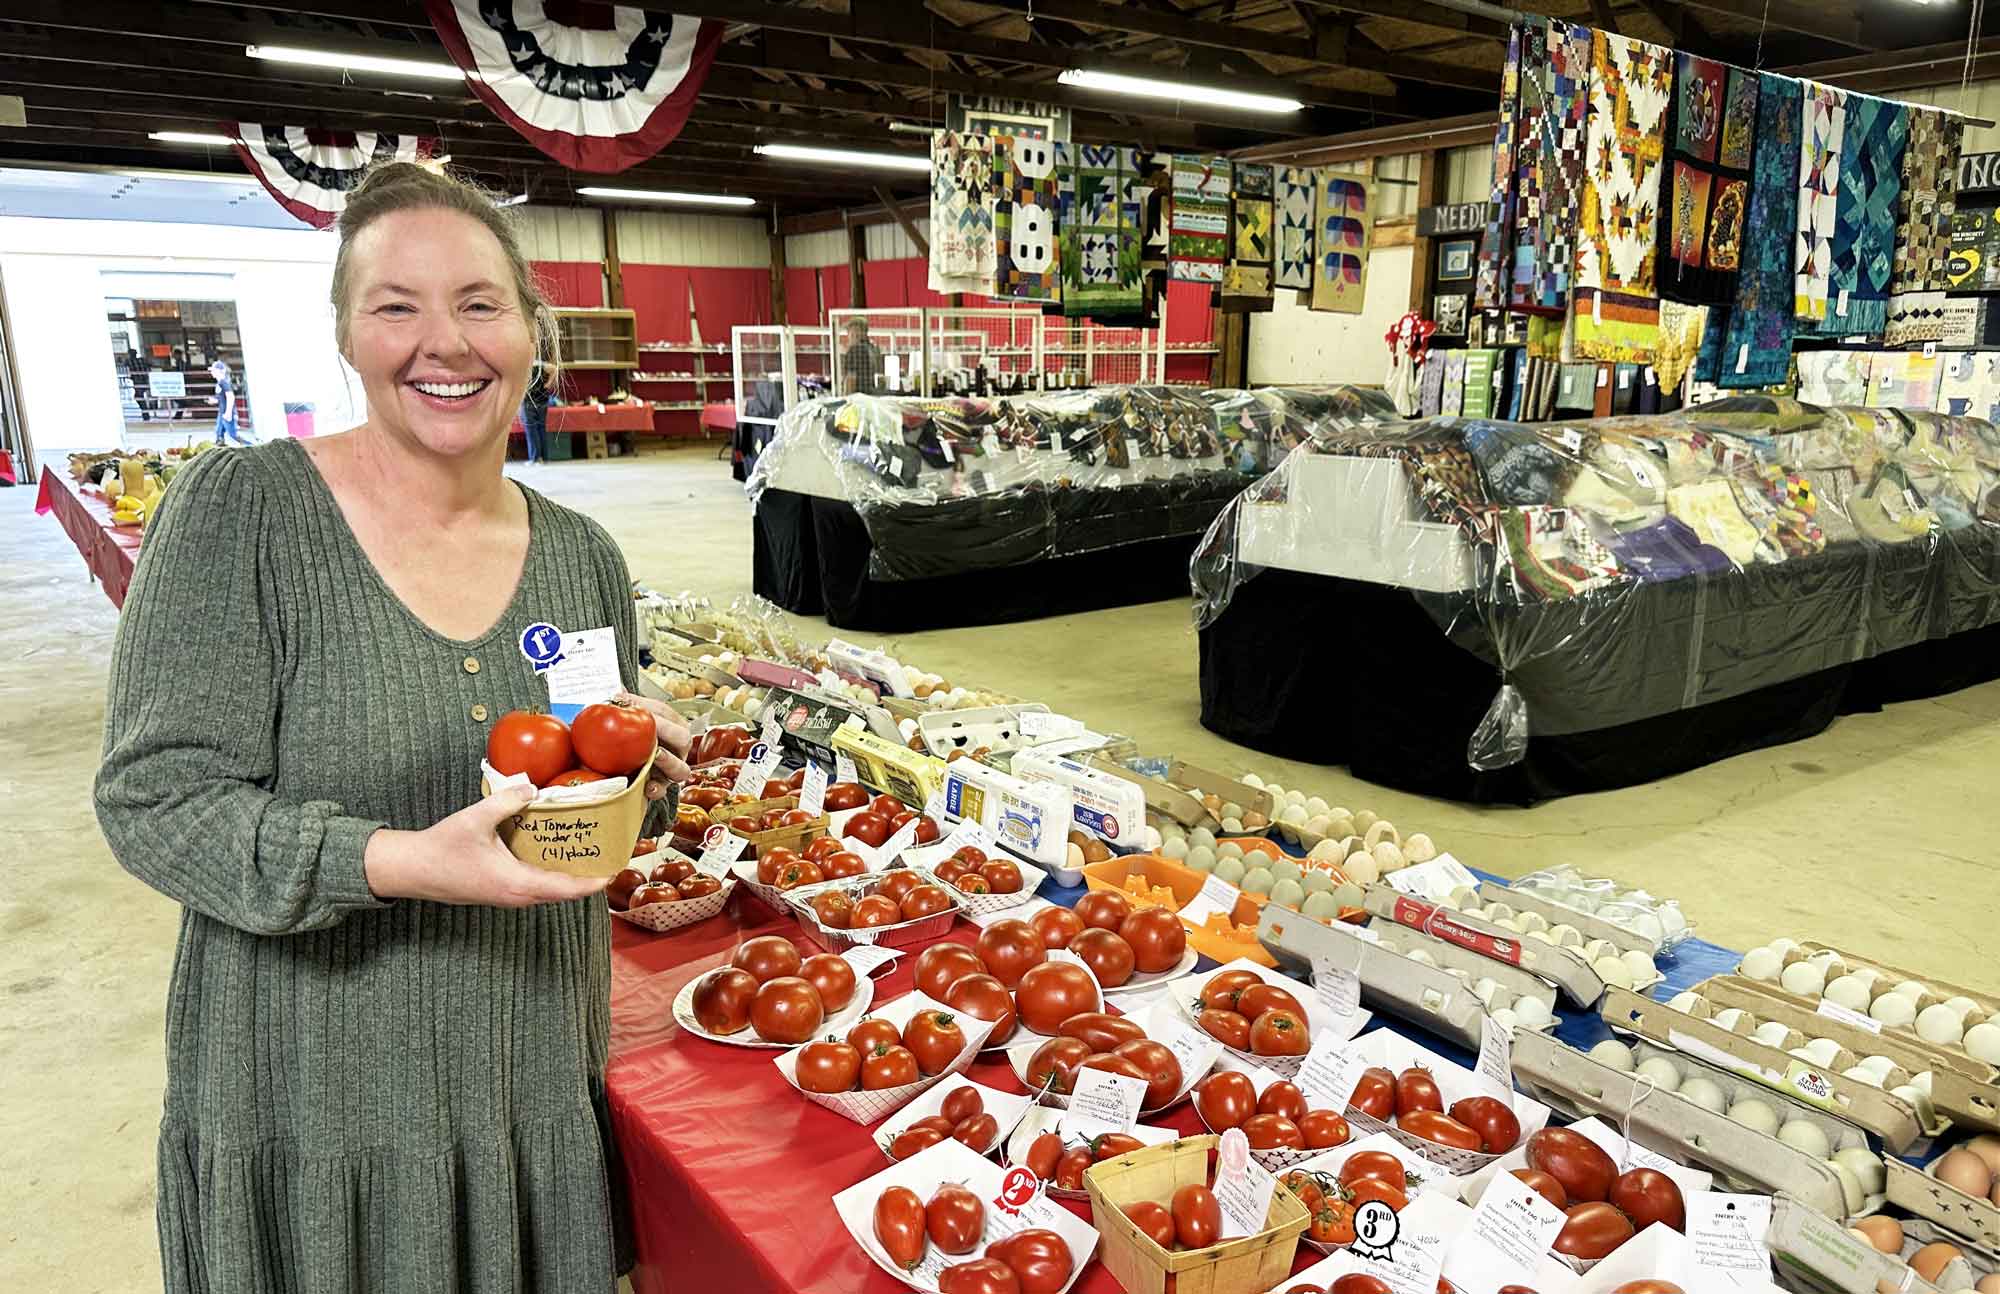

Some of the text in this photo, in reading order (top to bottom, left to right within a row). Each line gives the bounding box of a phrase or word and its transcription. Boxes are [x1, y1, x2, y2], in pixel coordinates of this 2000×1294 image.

[949, 781, 959, 812] LARGE
[512, 815, 538, 831] Red
[534, 832, 570, 842] under
[1363, 1209, 1392, 1239] 3RD
